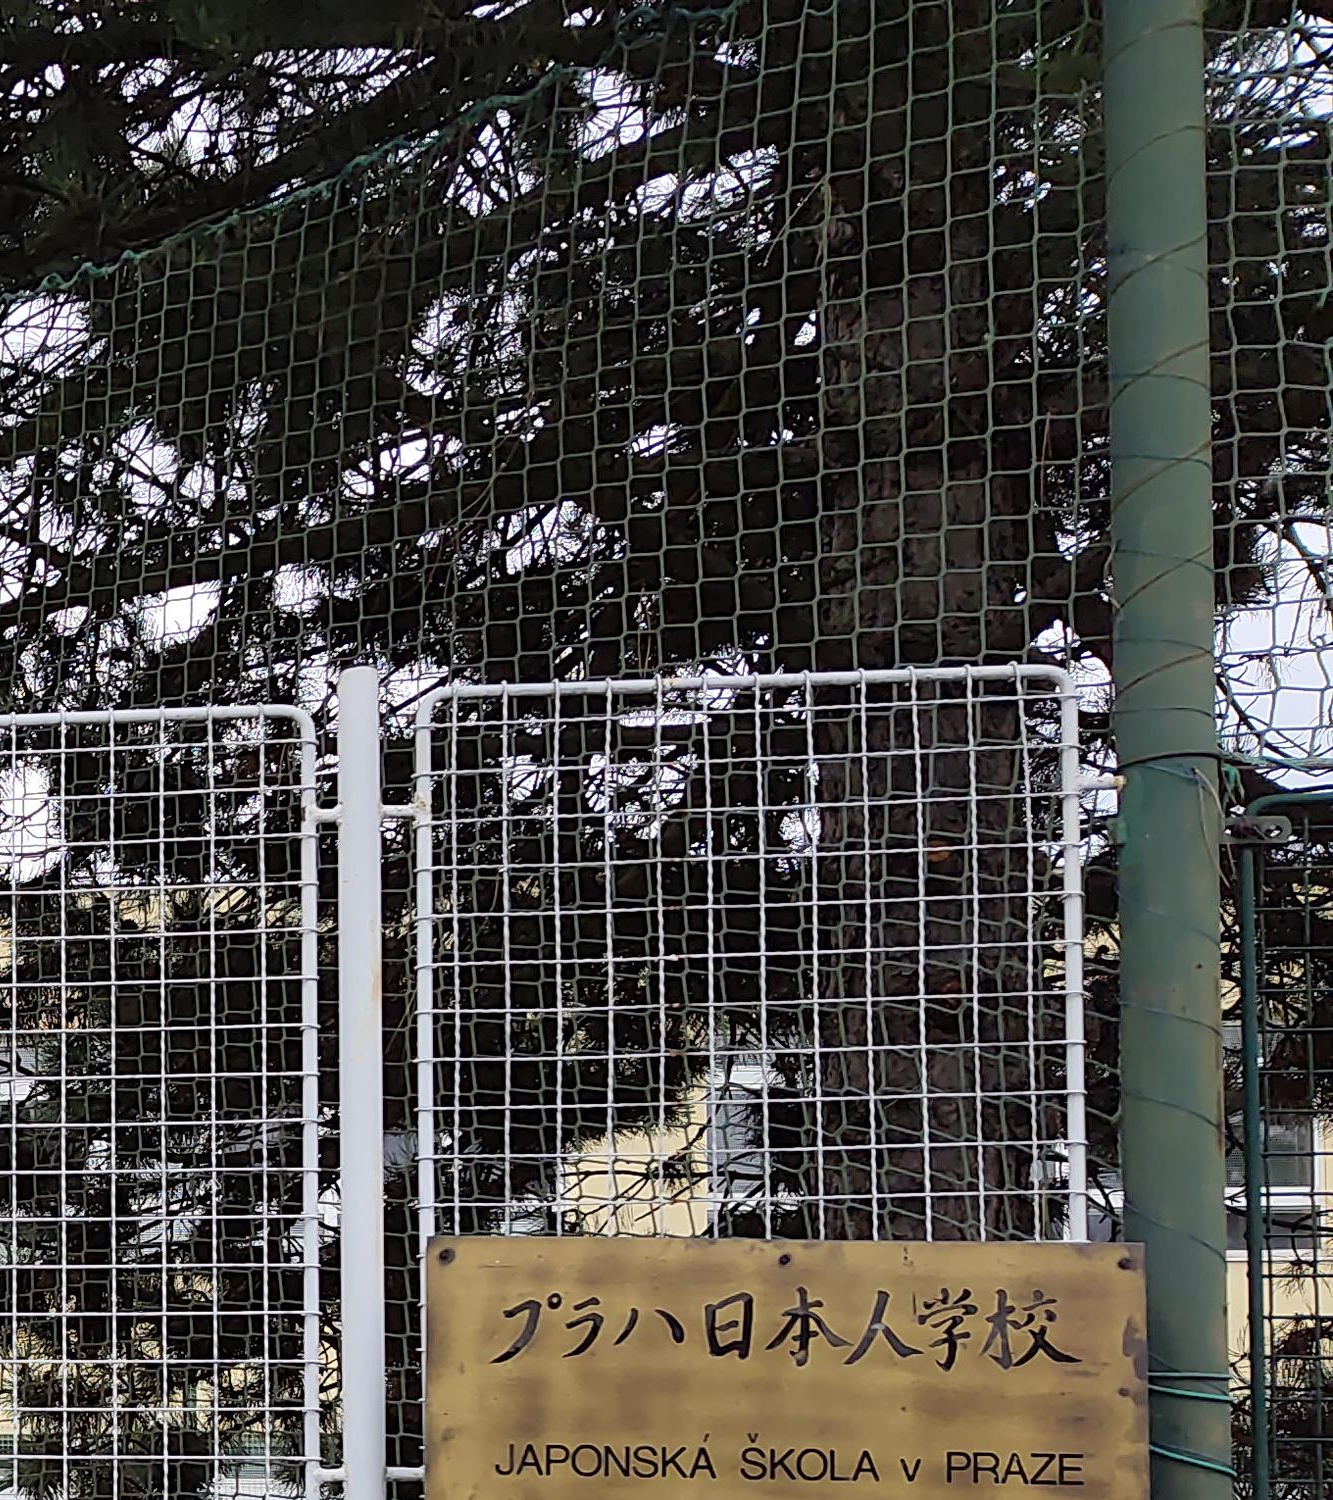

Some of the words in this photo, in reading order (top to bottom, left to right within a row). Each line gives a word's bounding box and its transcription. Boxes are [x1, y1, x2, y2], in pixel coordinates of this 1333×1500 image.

[490, 1286, 1083, 1372] プラハ日本人学校
[495, 1435, 717, 1480] JAPONSKÁ
[740, 1433, 880, 1483] ŠKOLA
[901, 1456, 923, 1484] v
[946, 1450, 1085, 1487] PRAZE
